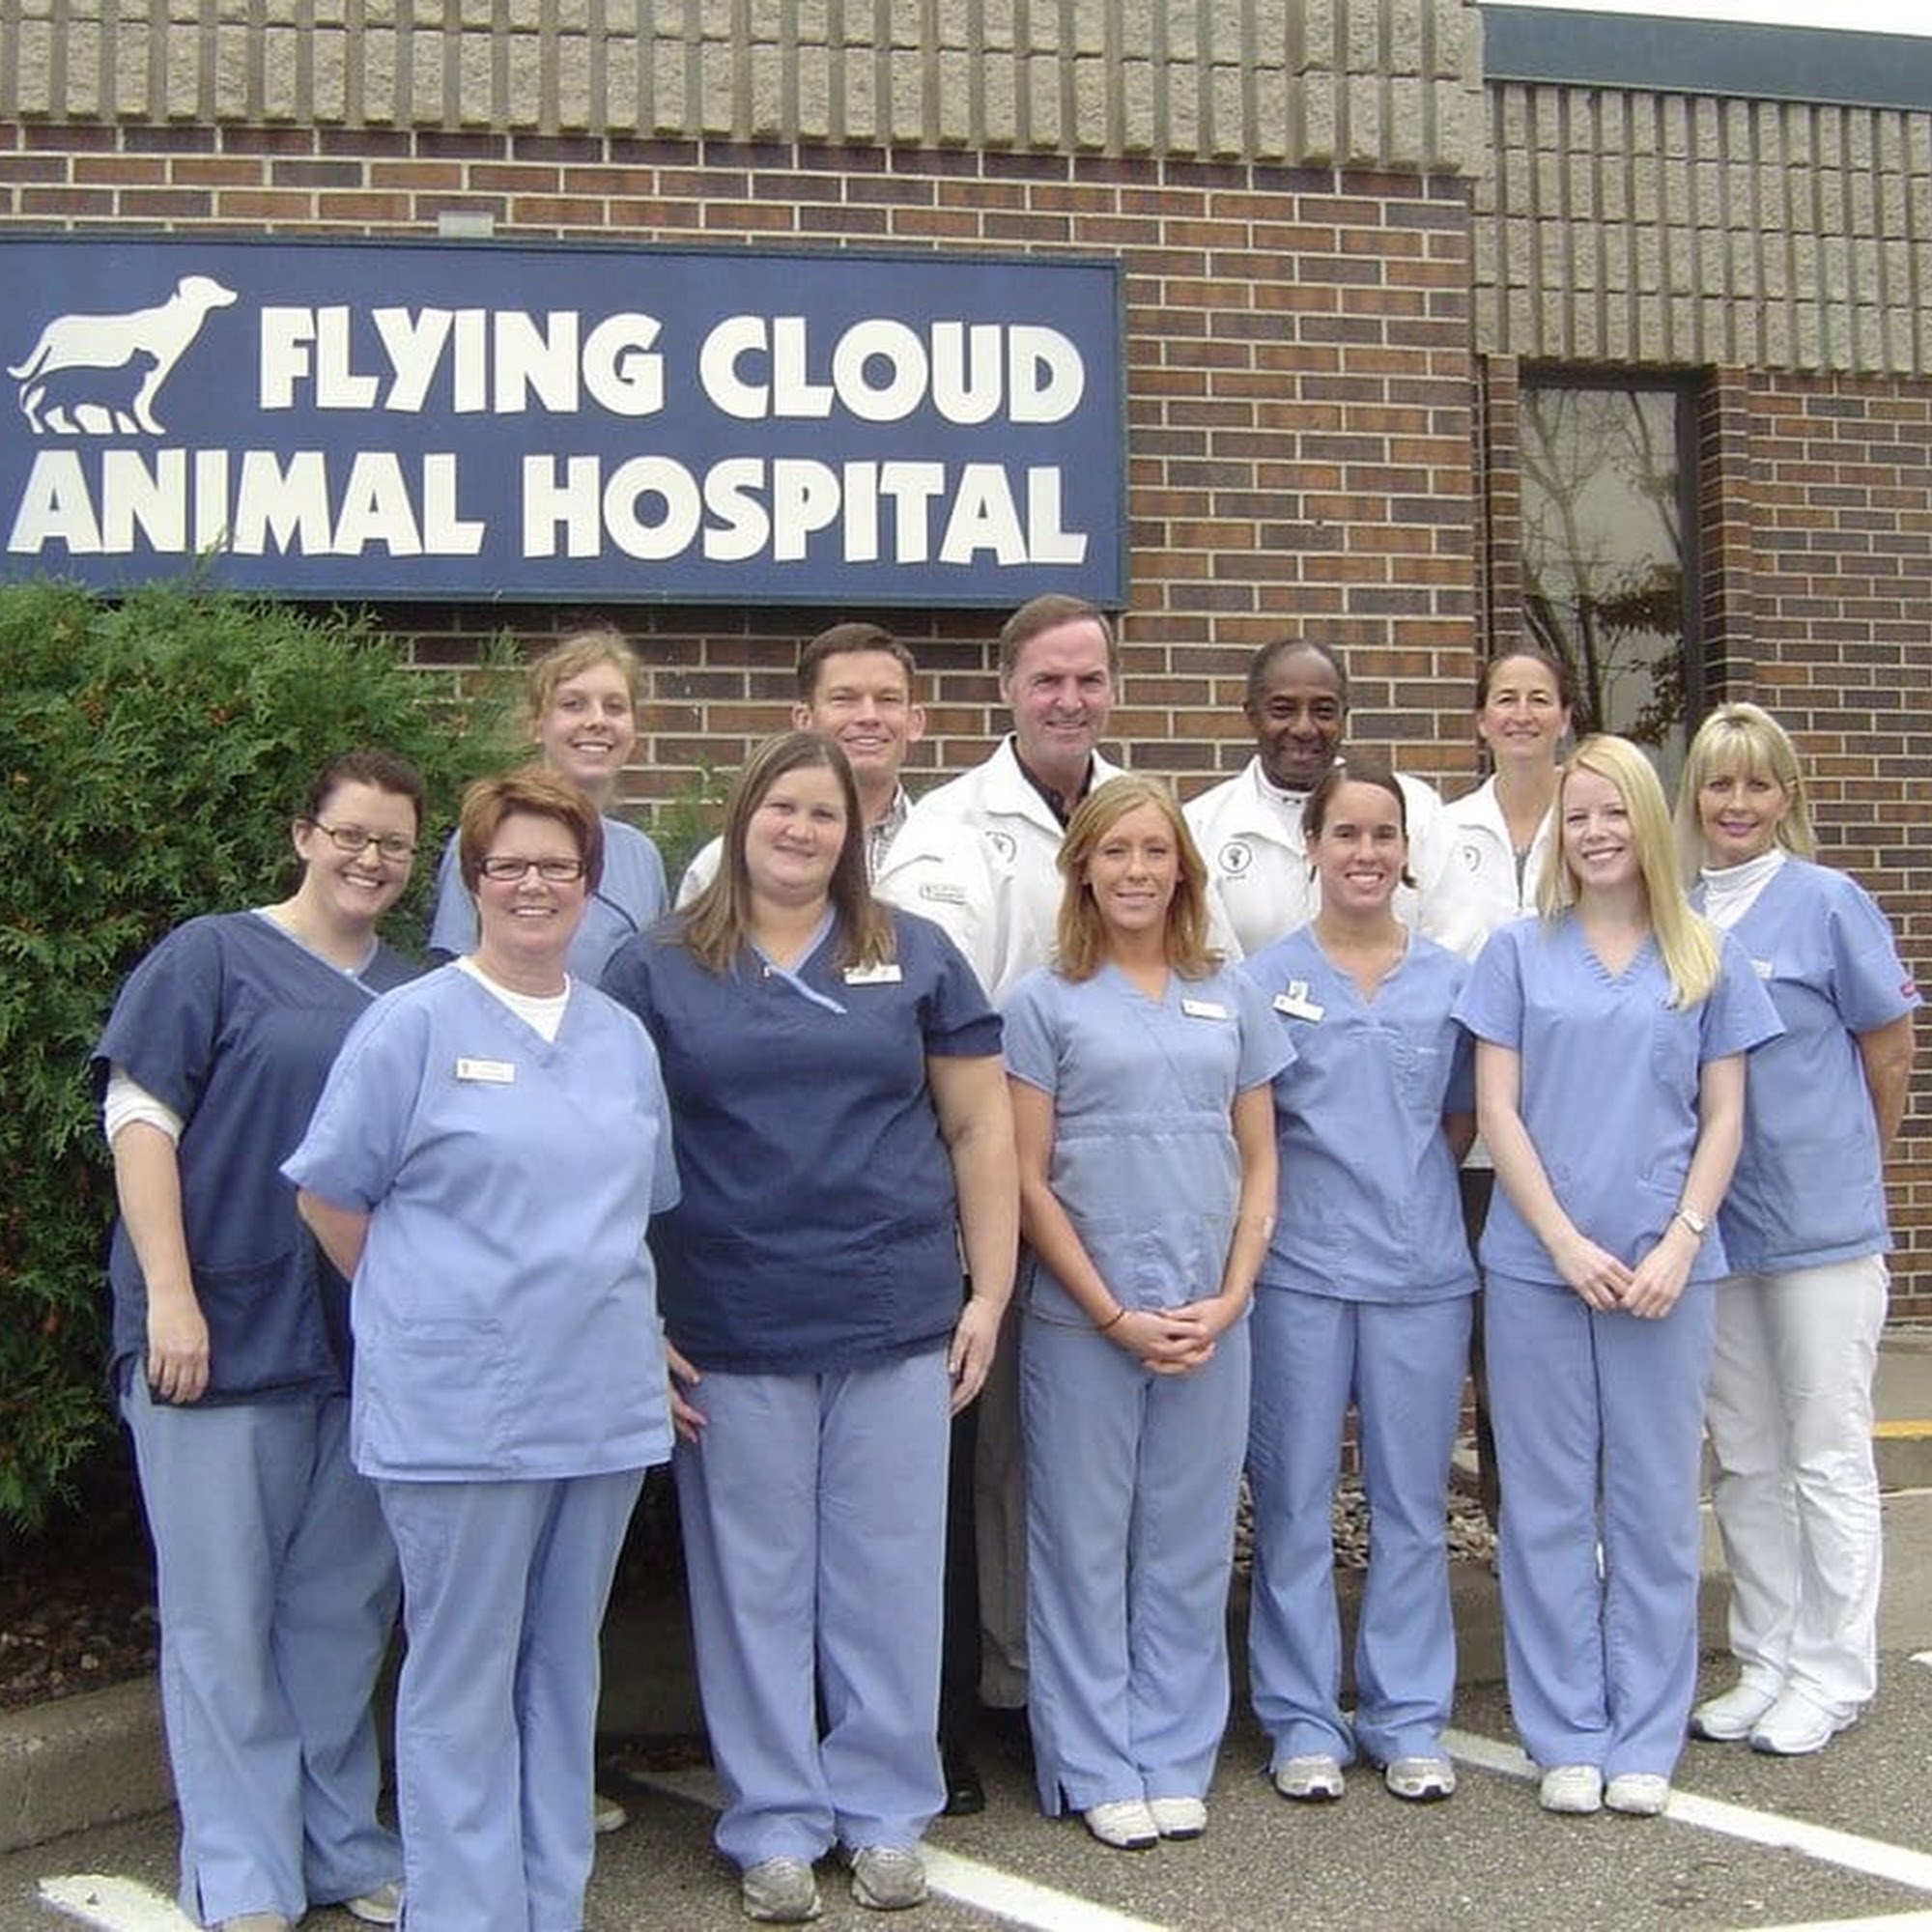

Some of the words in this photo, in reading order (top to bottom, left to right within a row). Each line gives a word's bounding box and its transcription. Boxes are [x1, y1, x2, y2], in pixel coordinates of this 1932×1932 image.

[260, 305, 665, 416] FLYING
[699, 315, 1085, 425] CLOUD
[7, 447, 486, 556] ANIMAL
[523, 454, 1089, 566] HOSPITAL
